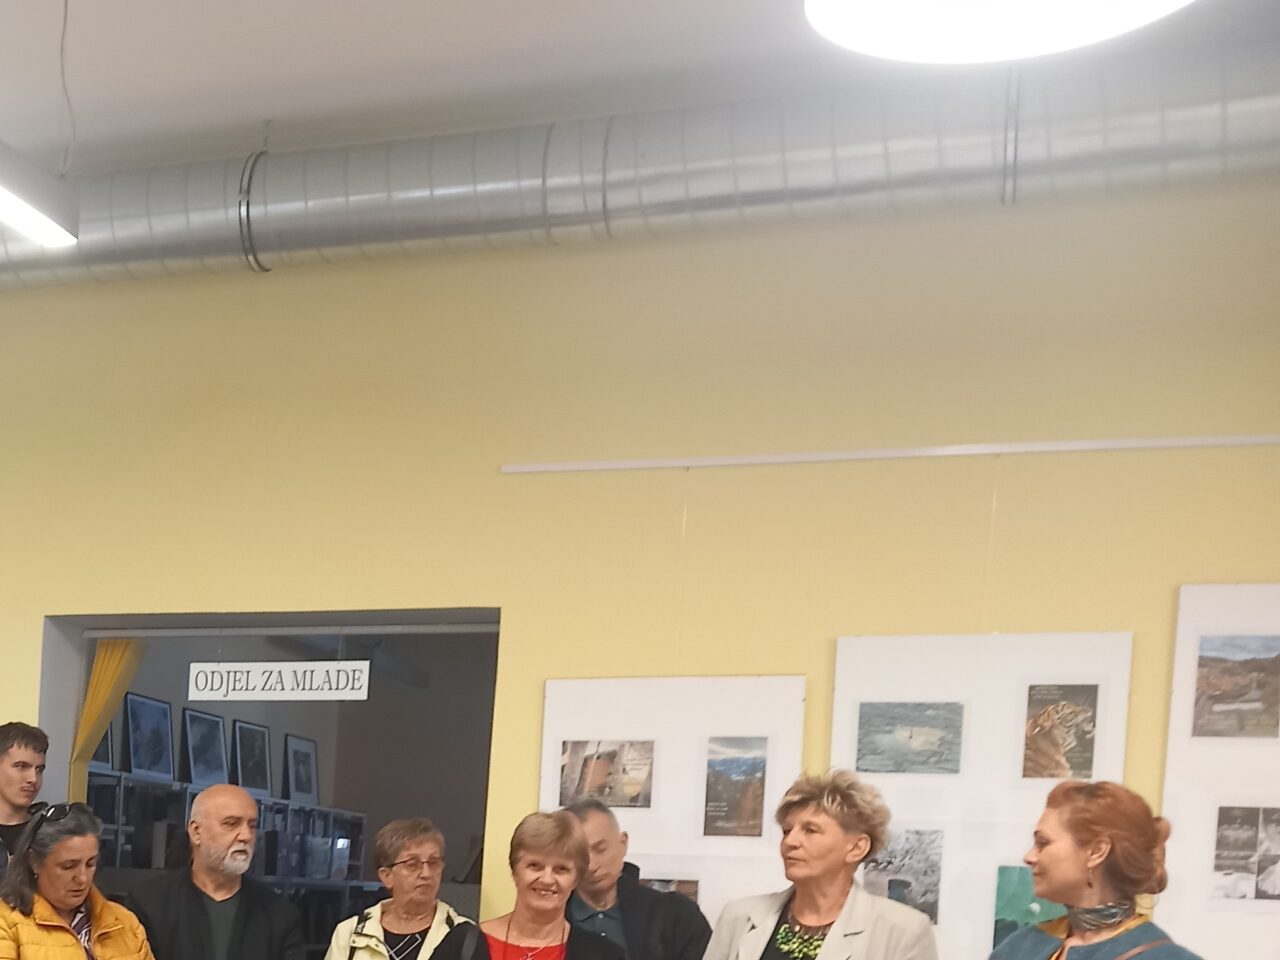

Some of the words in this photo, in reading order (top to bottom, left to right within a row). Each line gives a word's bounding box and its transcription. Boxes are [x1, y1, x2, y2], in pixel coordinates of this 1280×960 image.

[194, 670, 257, 698] ODJEL
[260, 669, 286, 692] ZA
[289, 668, 364, 692] MLADE
